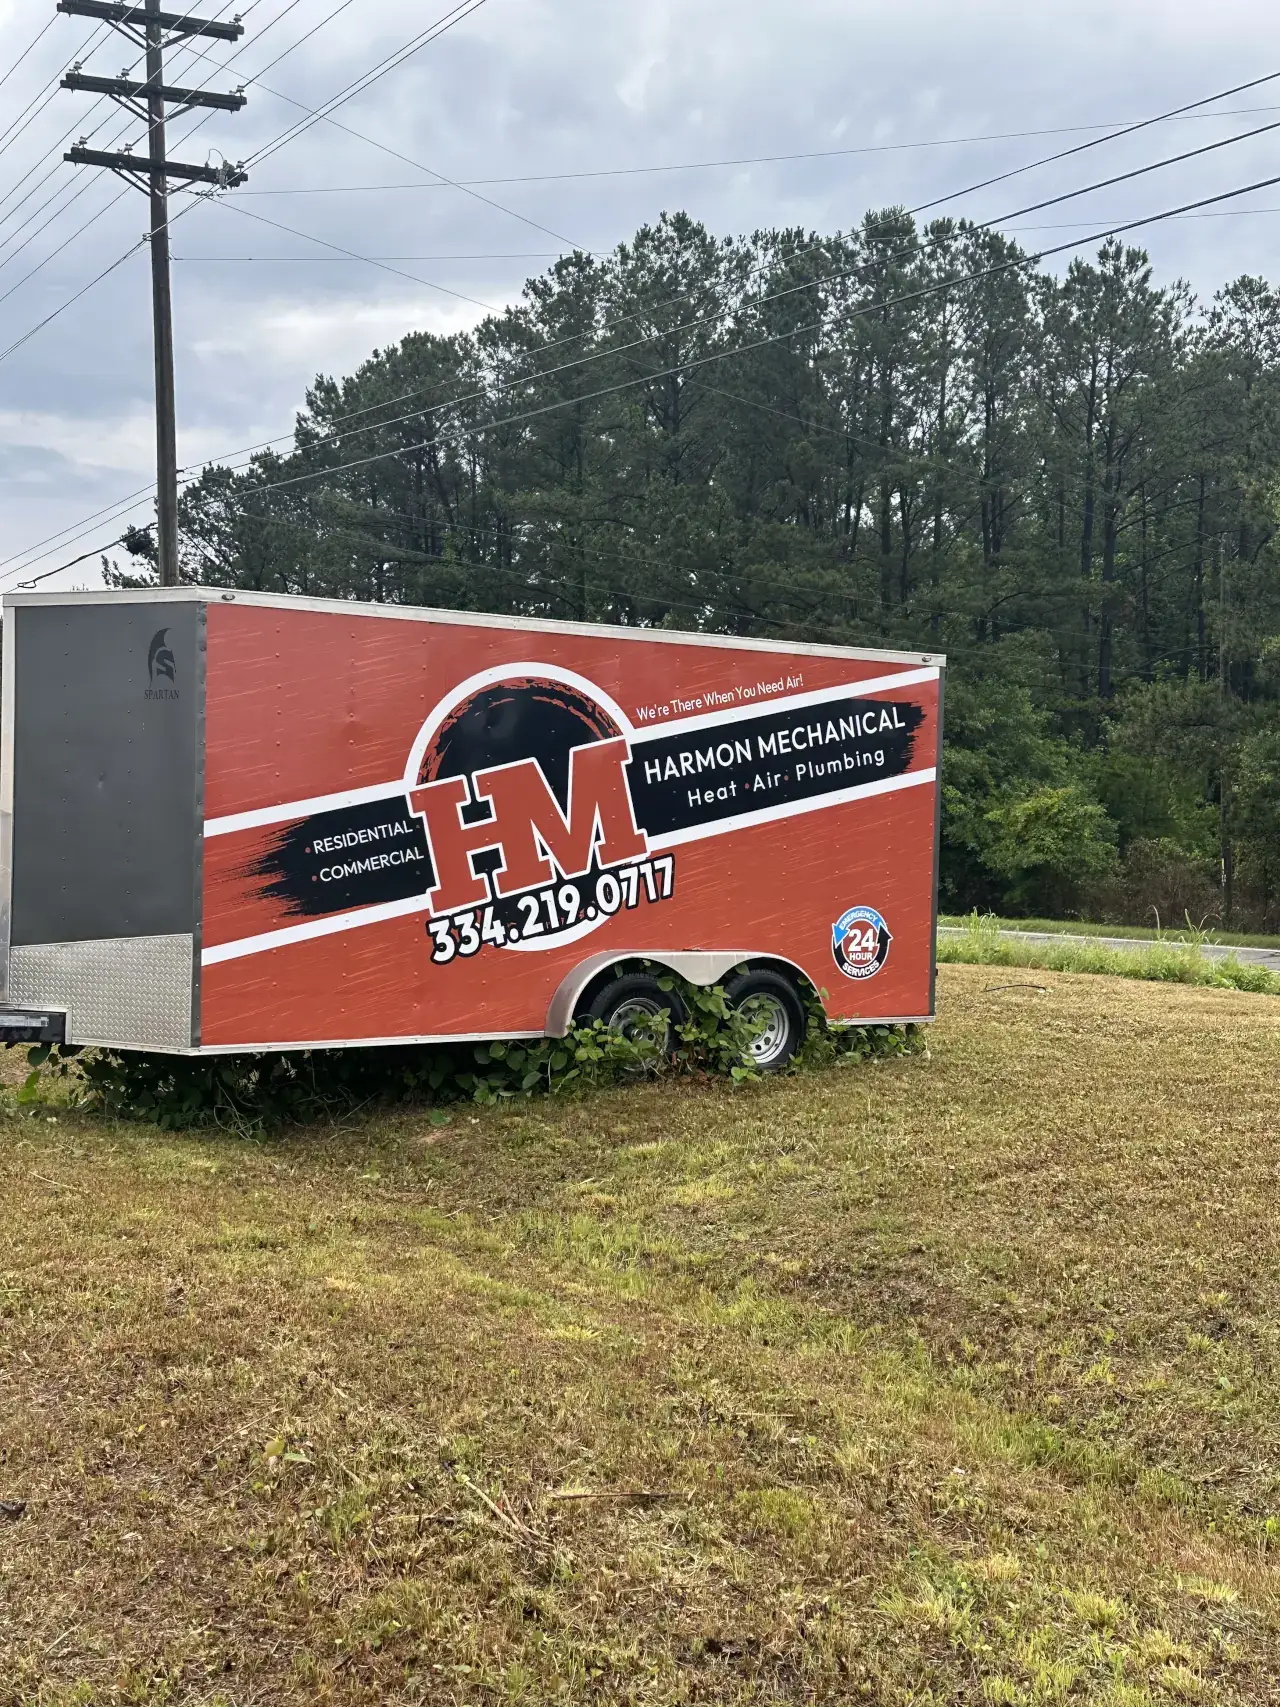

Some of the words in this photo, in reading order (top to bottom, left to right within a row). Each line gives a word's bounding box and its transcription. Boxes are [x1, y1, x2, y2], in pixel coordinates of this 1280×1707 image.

[144, 689, 180, 700] SPARTAN
[636, 704, 669, 721] We're
[670, 698, 702, 713] There
[703, 691, 734, 707] When
[735, 686, 756, 700] You
[757, 677, 784, 694] Need
[786, 674, 804, 689] Air!
[644, 739, 752, 784] HARMON
[757, 706, 906, 758] MECHANICAL
[687, 780, 737, 807] Heat
[752, 773, 782, 792] Air
[795, 748, 886, 782] Plumbing
[313, 820, 413, 854] RESIDENTIAL
[407, 738, 650, 916] HM
[319, 846, 424, 882] COMMERCIAL
[427, 855, 675, 963] 334.219.0717
[838, 910, 878, 930] EMERGENCY
[848, 928, 875, 952] 24
[849, 952, 873, 960] HOUR
[842, 960, 880, 976] SERVICES
